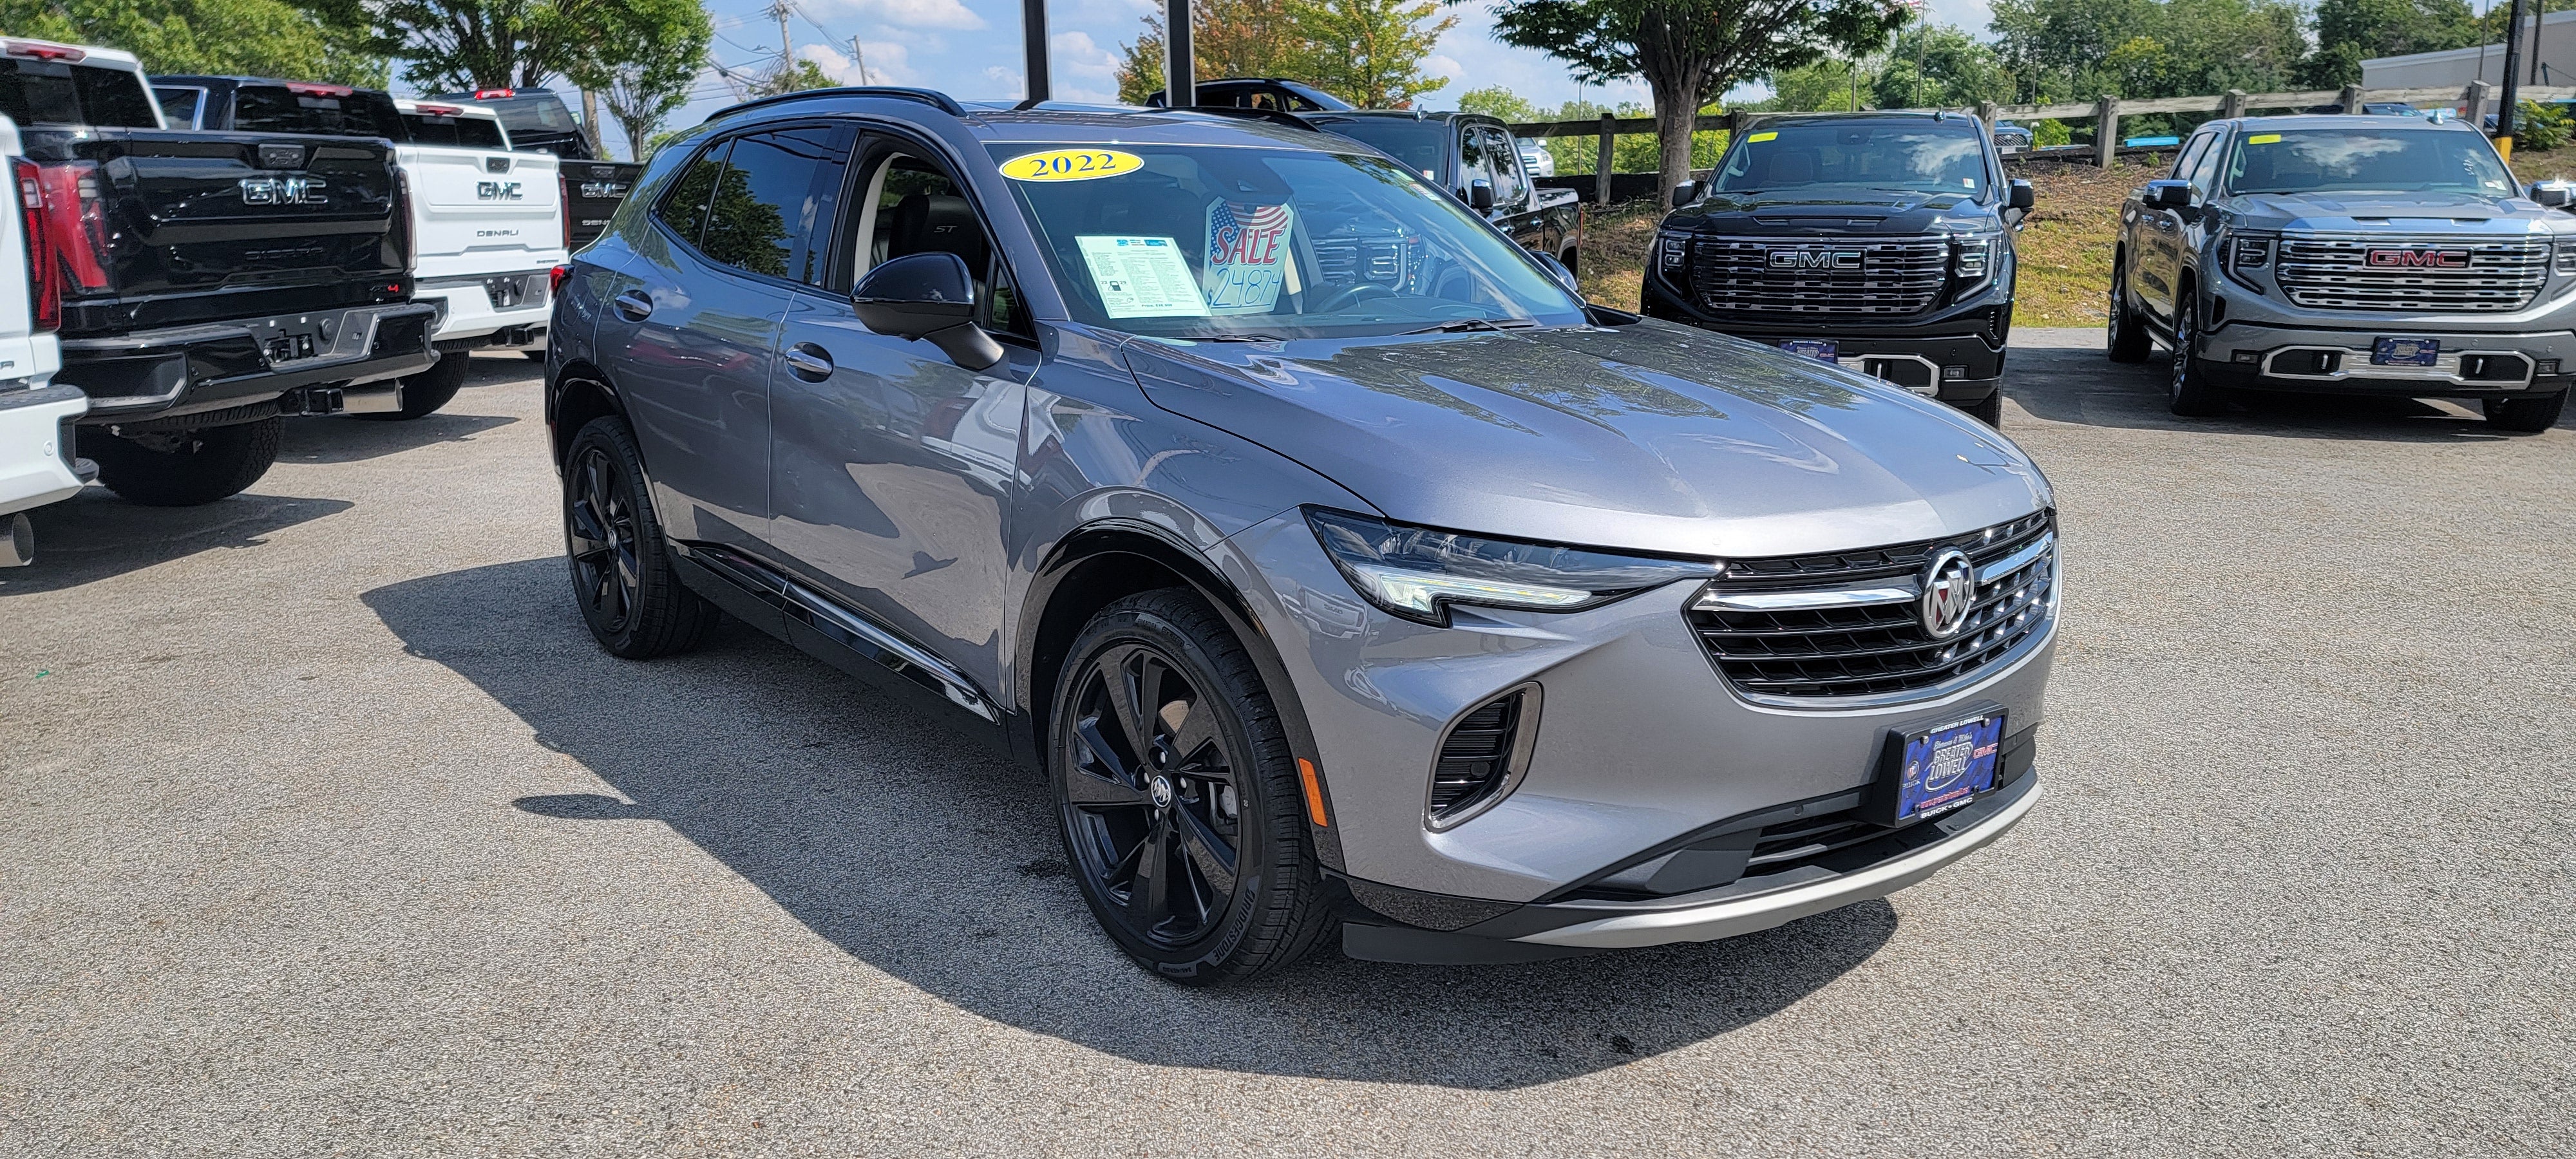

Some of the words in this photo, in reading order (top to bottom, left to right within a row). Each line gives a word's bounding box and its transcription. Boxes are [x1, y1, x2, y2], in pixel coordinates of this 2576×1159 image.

[1029, 153, 1116, 177] 2022
[238, 178, 328, 205] GMC
[477, 182, 523, 200] GMC
[580, 183, 627, 198] GMC
[1210, 227, 1284, 265] SALE
[1770, 250, 1861, 269] GMC
[2369, 250, 2468, 268] GMC
[1930, 722, 1959, 734] GREATER
[1960, 715, 1984, 726] LOWELL
[1934, 742, 1972, 764] GREATER
[1973, 743, 1998, 759] GMC
[1929, 757, 1967, 781] LOWELL
[1213, 889, 1256, 962] BRIDGESTONE
